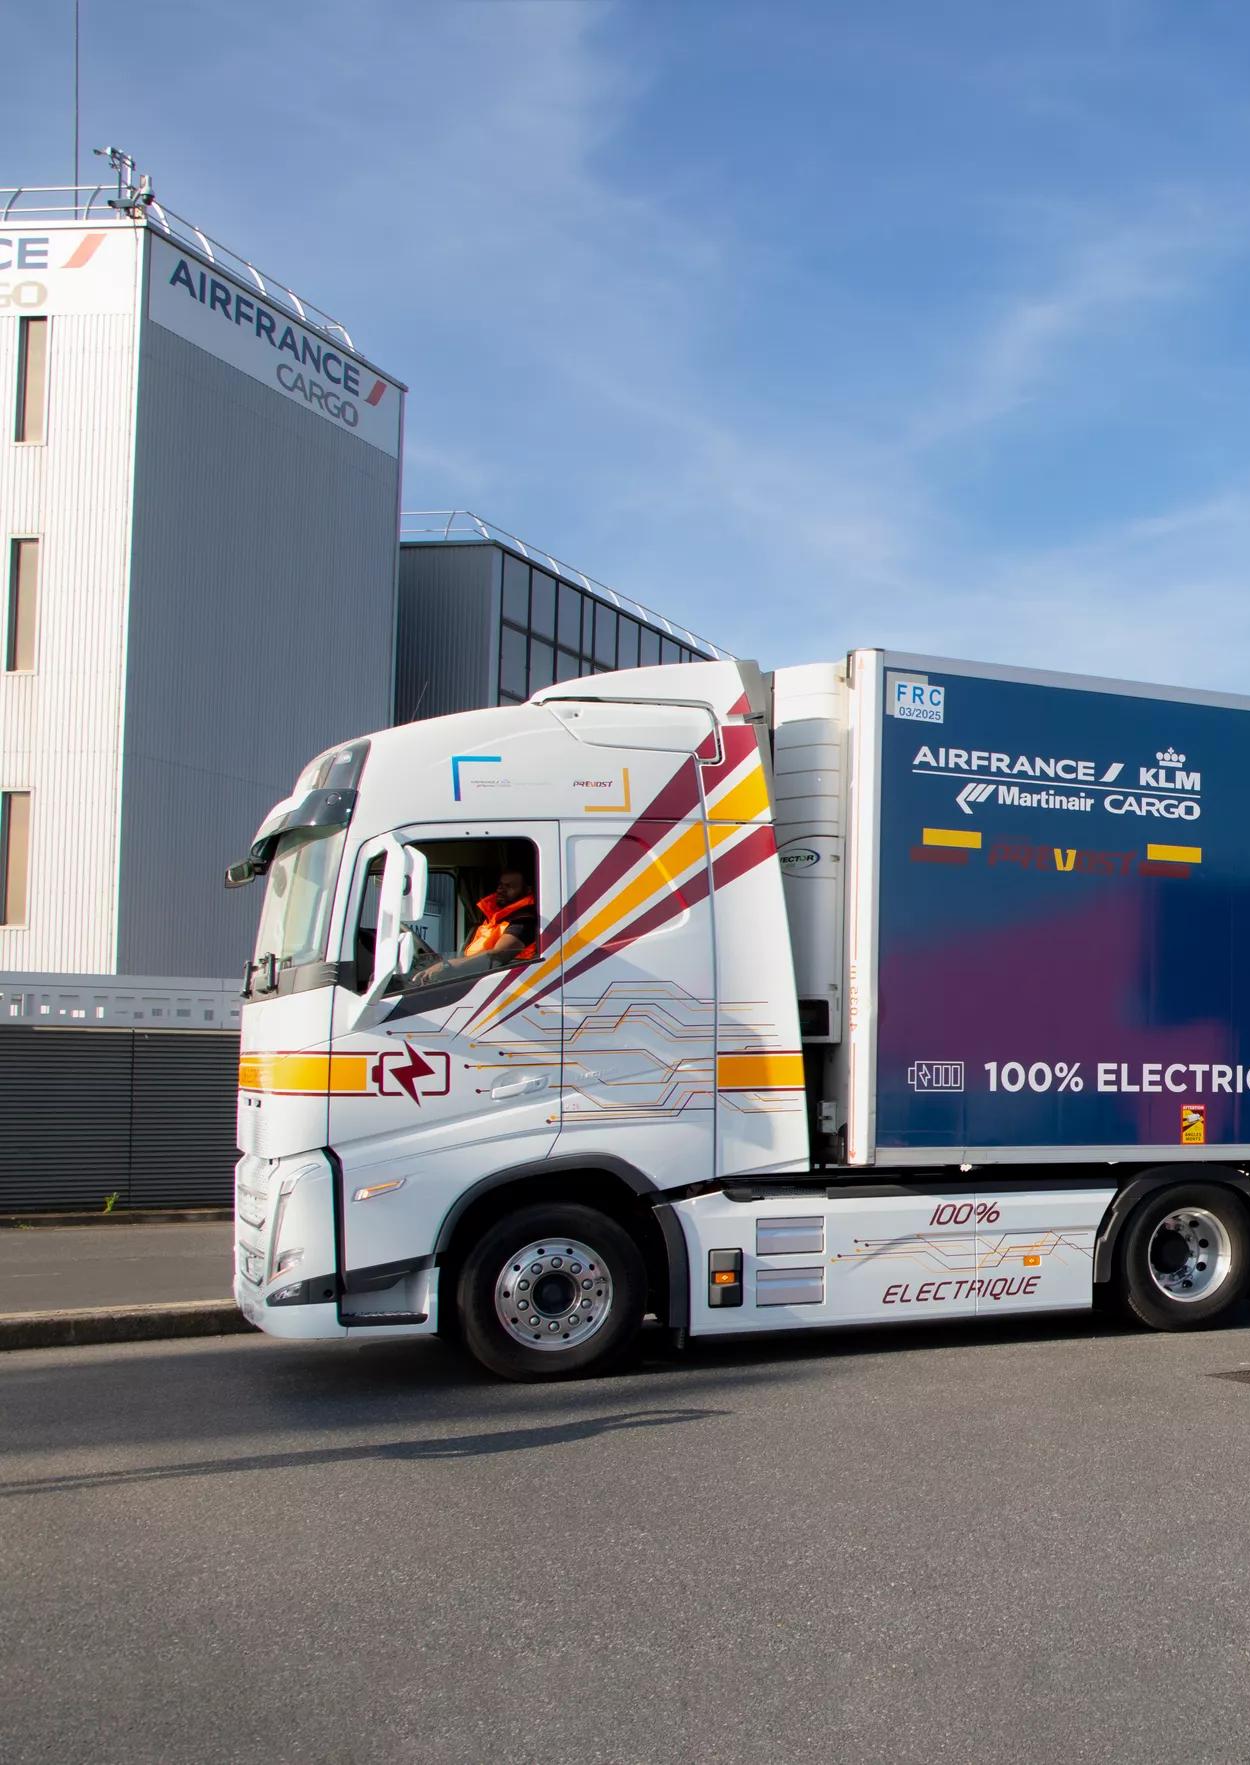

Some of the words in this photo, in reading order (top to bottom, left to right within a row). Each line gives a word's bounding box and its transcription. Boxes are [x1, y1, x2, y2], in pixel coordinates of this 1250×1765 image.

[169, 259, 361, 397] AIRFRANCE
[276, 363, 359, 427] CARGO
[899, 706, 941, 720] 03/2025
[913, 746, 1095, 781] AIRFRANCE
[1139, 767, 1200, 791] KLM
[998, 785, 1095, 812] Martinair
[1104, 794, 1200, 821] CARGO
[984, 1061, 1084, 1093] 100%
[929, 1202, 1001, 1226] 100%
[882, 1275, 1042, 1304] ELECTRIQUE
